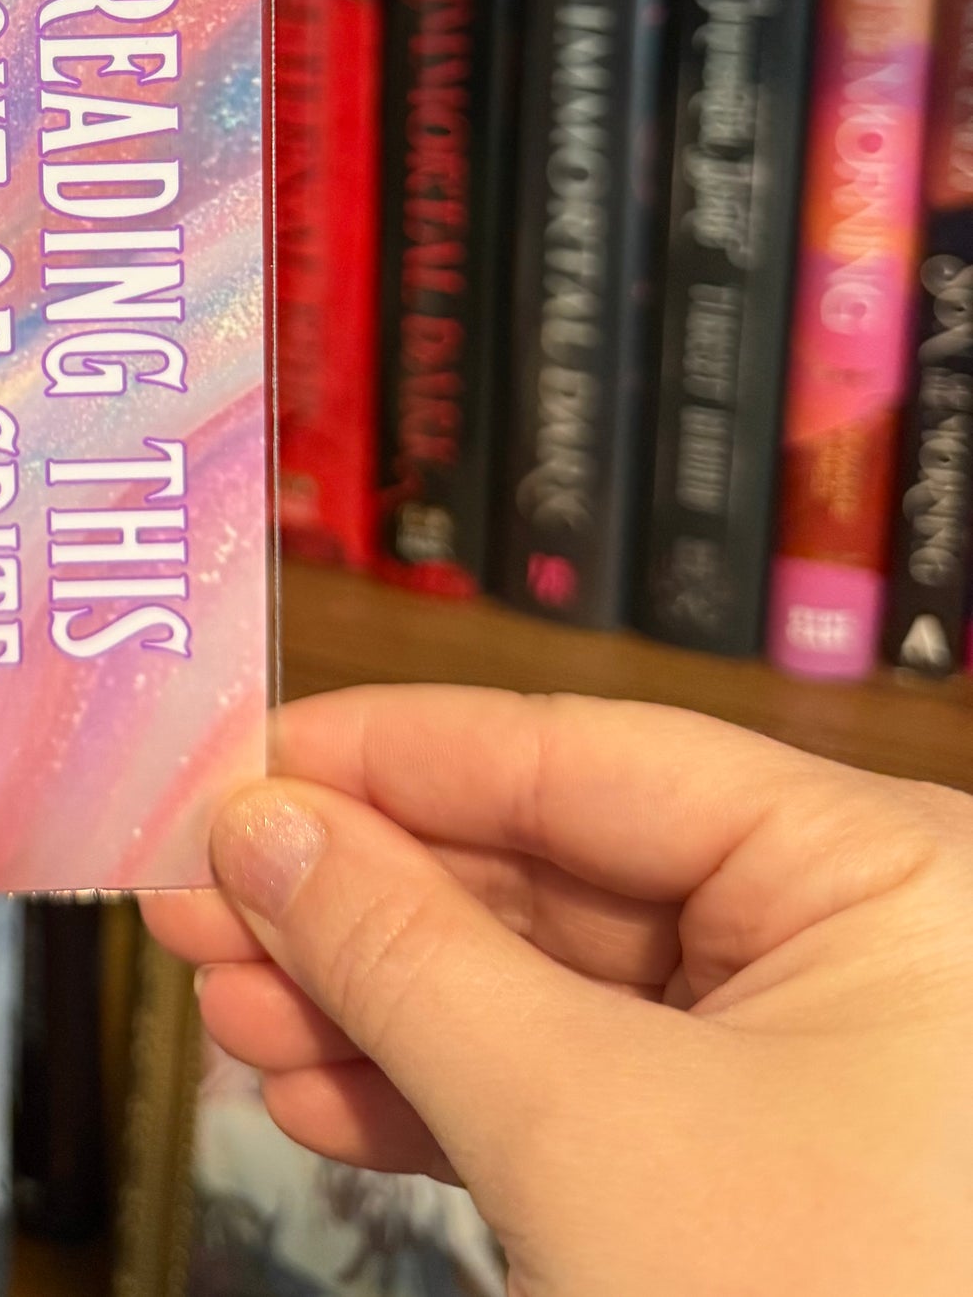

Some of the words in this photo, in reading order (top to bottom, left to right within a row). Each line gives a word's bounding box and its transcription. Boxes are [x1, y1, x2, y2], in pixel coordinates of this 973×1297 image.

[539, 4, 615, 364] IMMORTAL
[820, 59, 908, 338] MORNING
[45, 436, 192, 659] THIS
